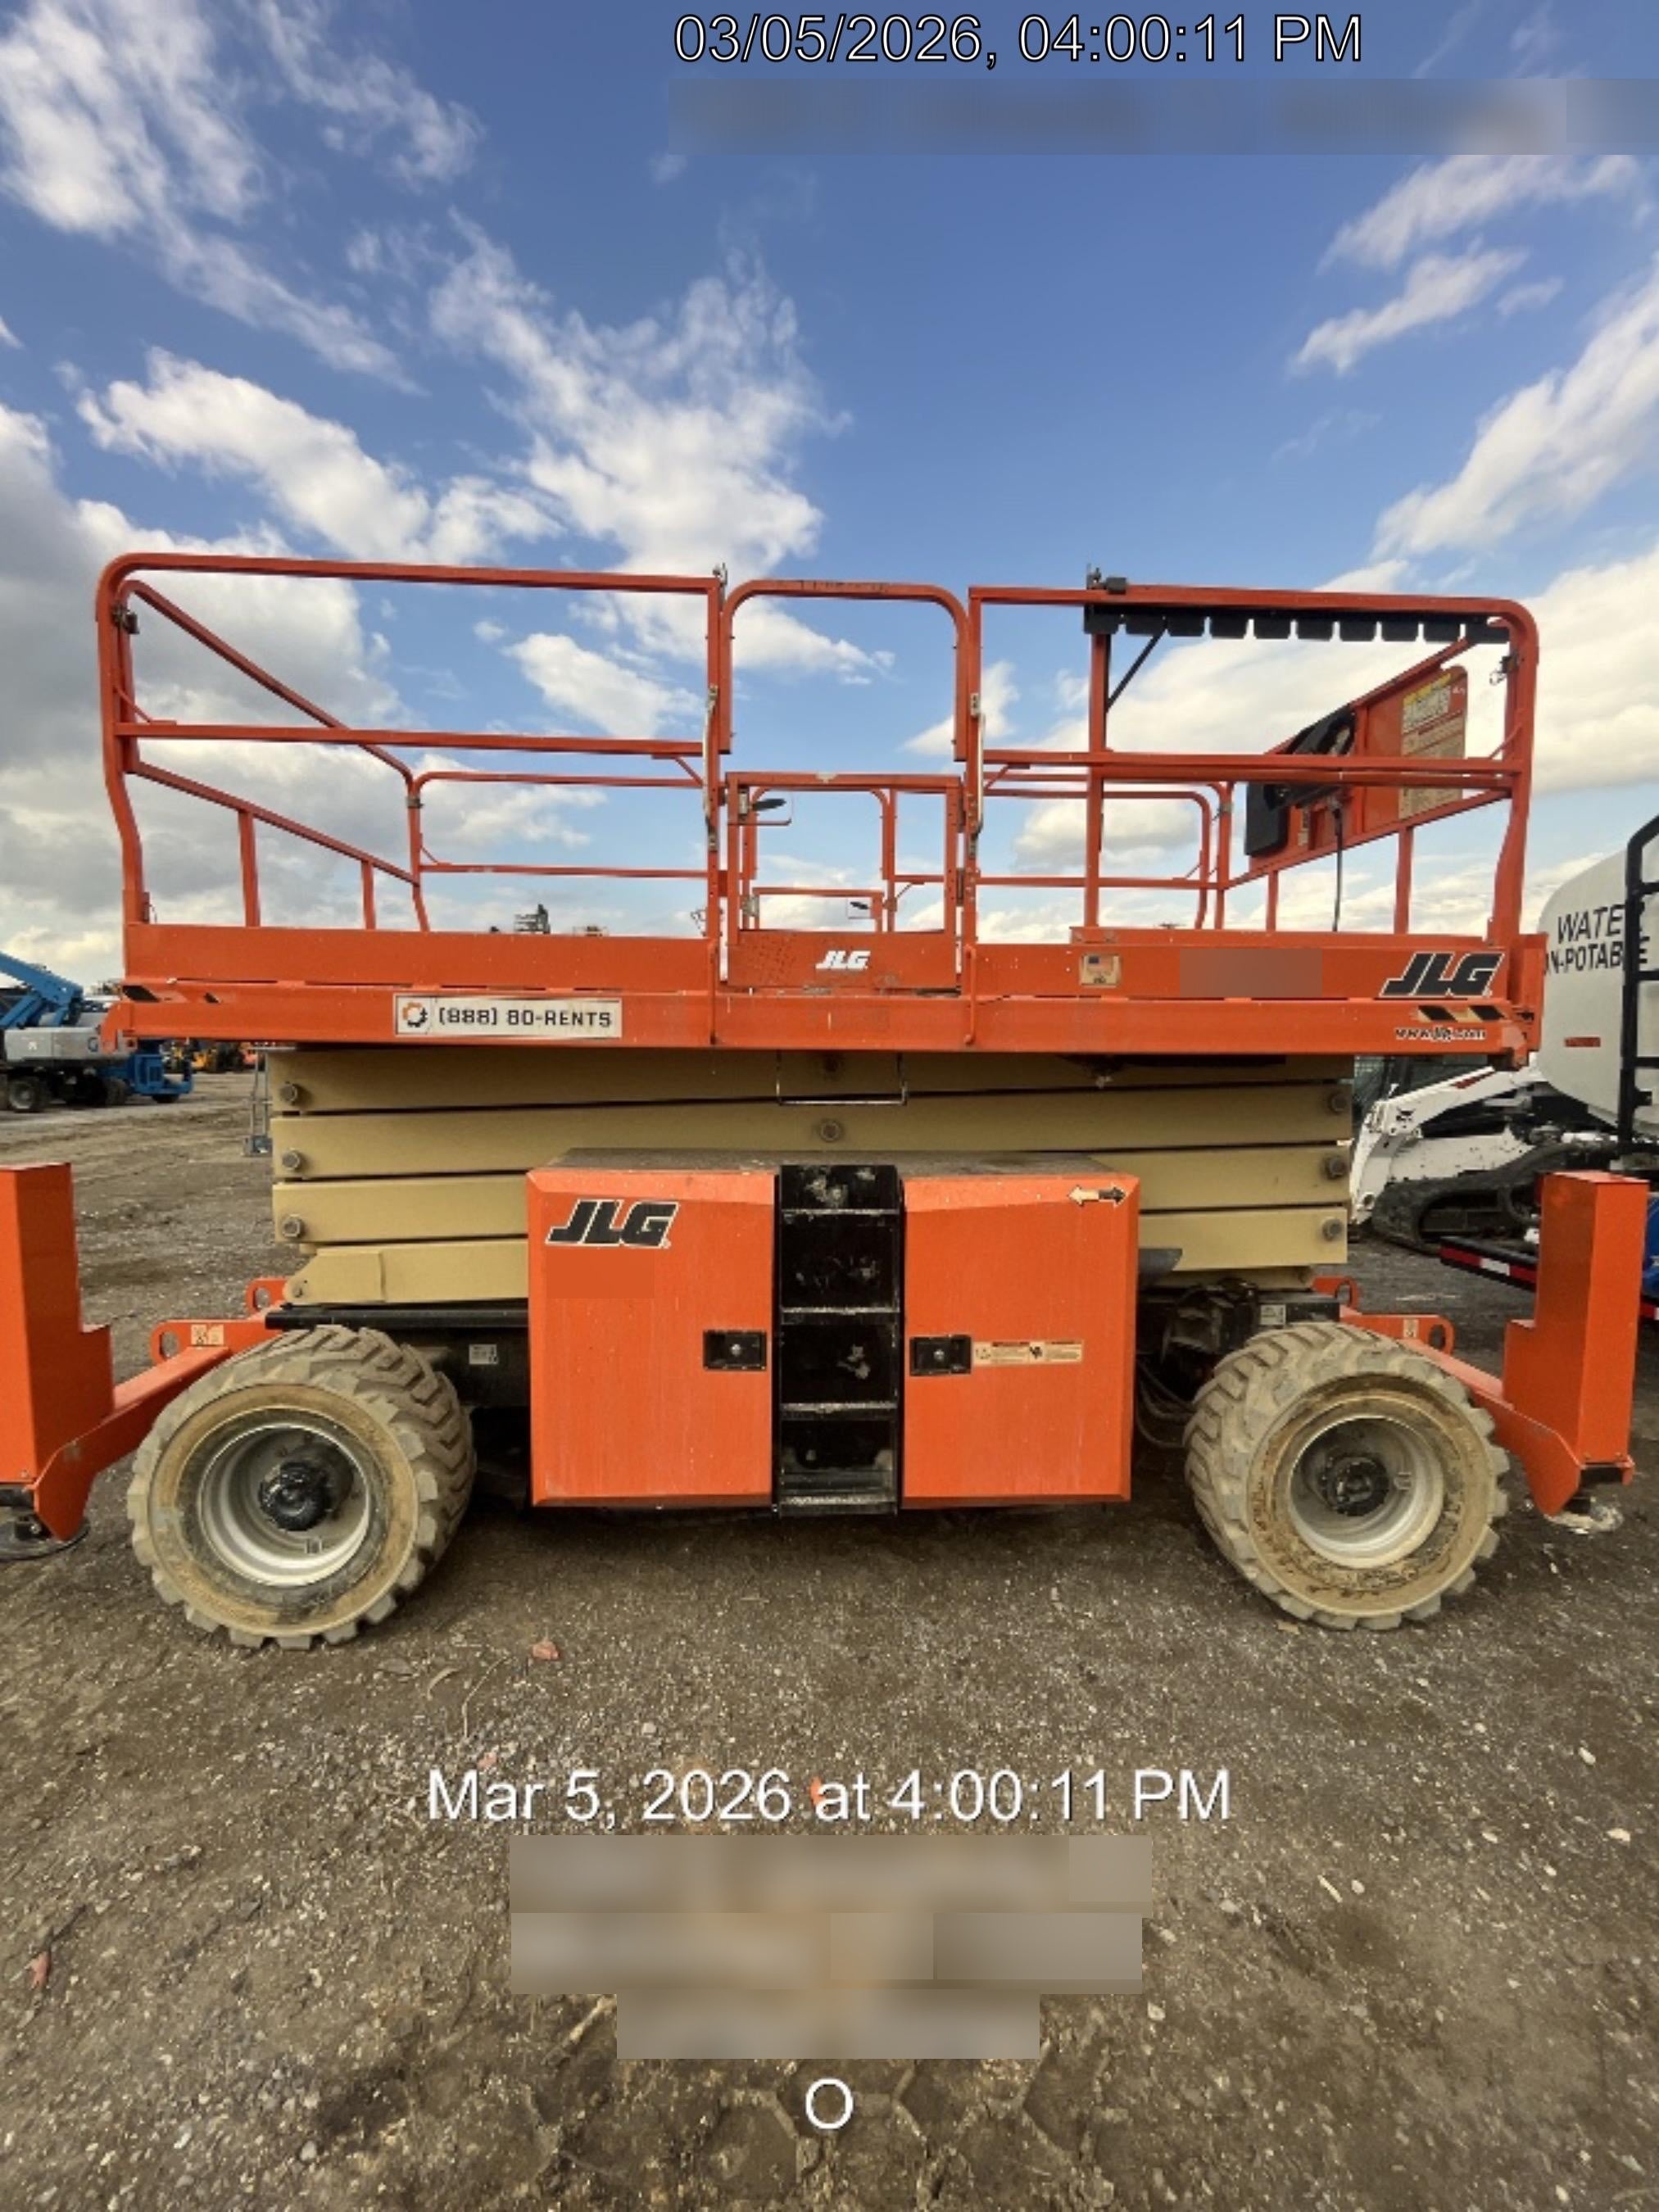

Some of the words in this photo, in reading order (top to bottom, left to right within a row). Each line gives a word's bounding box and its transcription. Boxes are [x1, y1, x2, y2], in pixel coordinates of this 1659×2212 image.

[814, 950, 871, 970] JLG
[1380, 951, 1505, 997] JLG
[507, 1009, 612, 1028] 80-RENTS
[545, 1199, 680, 1250] JLG
